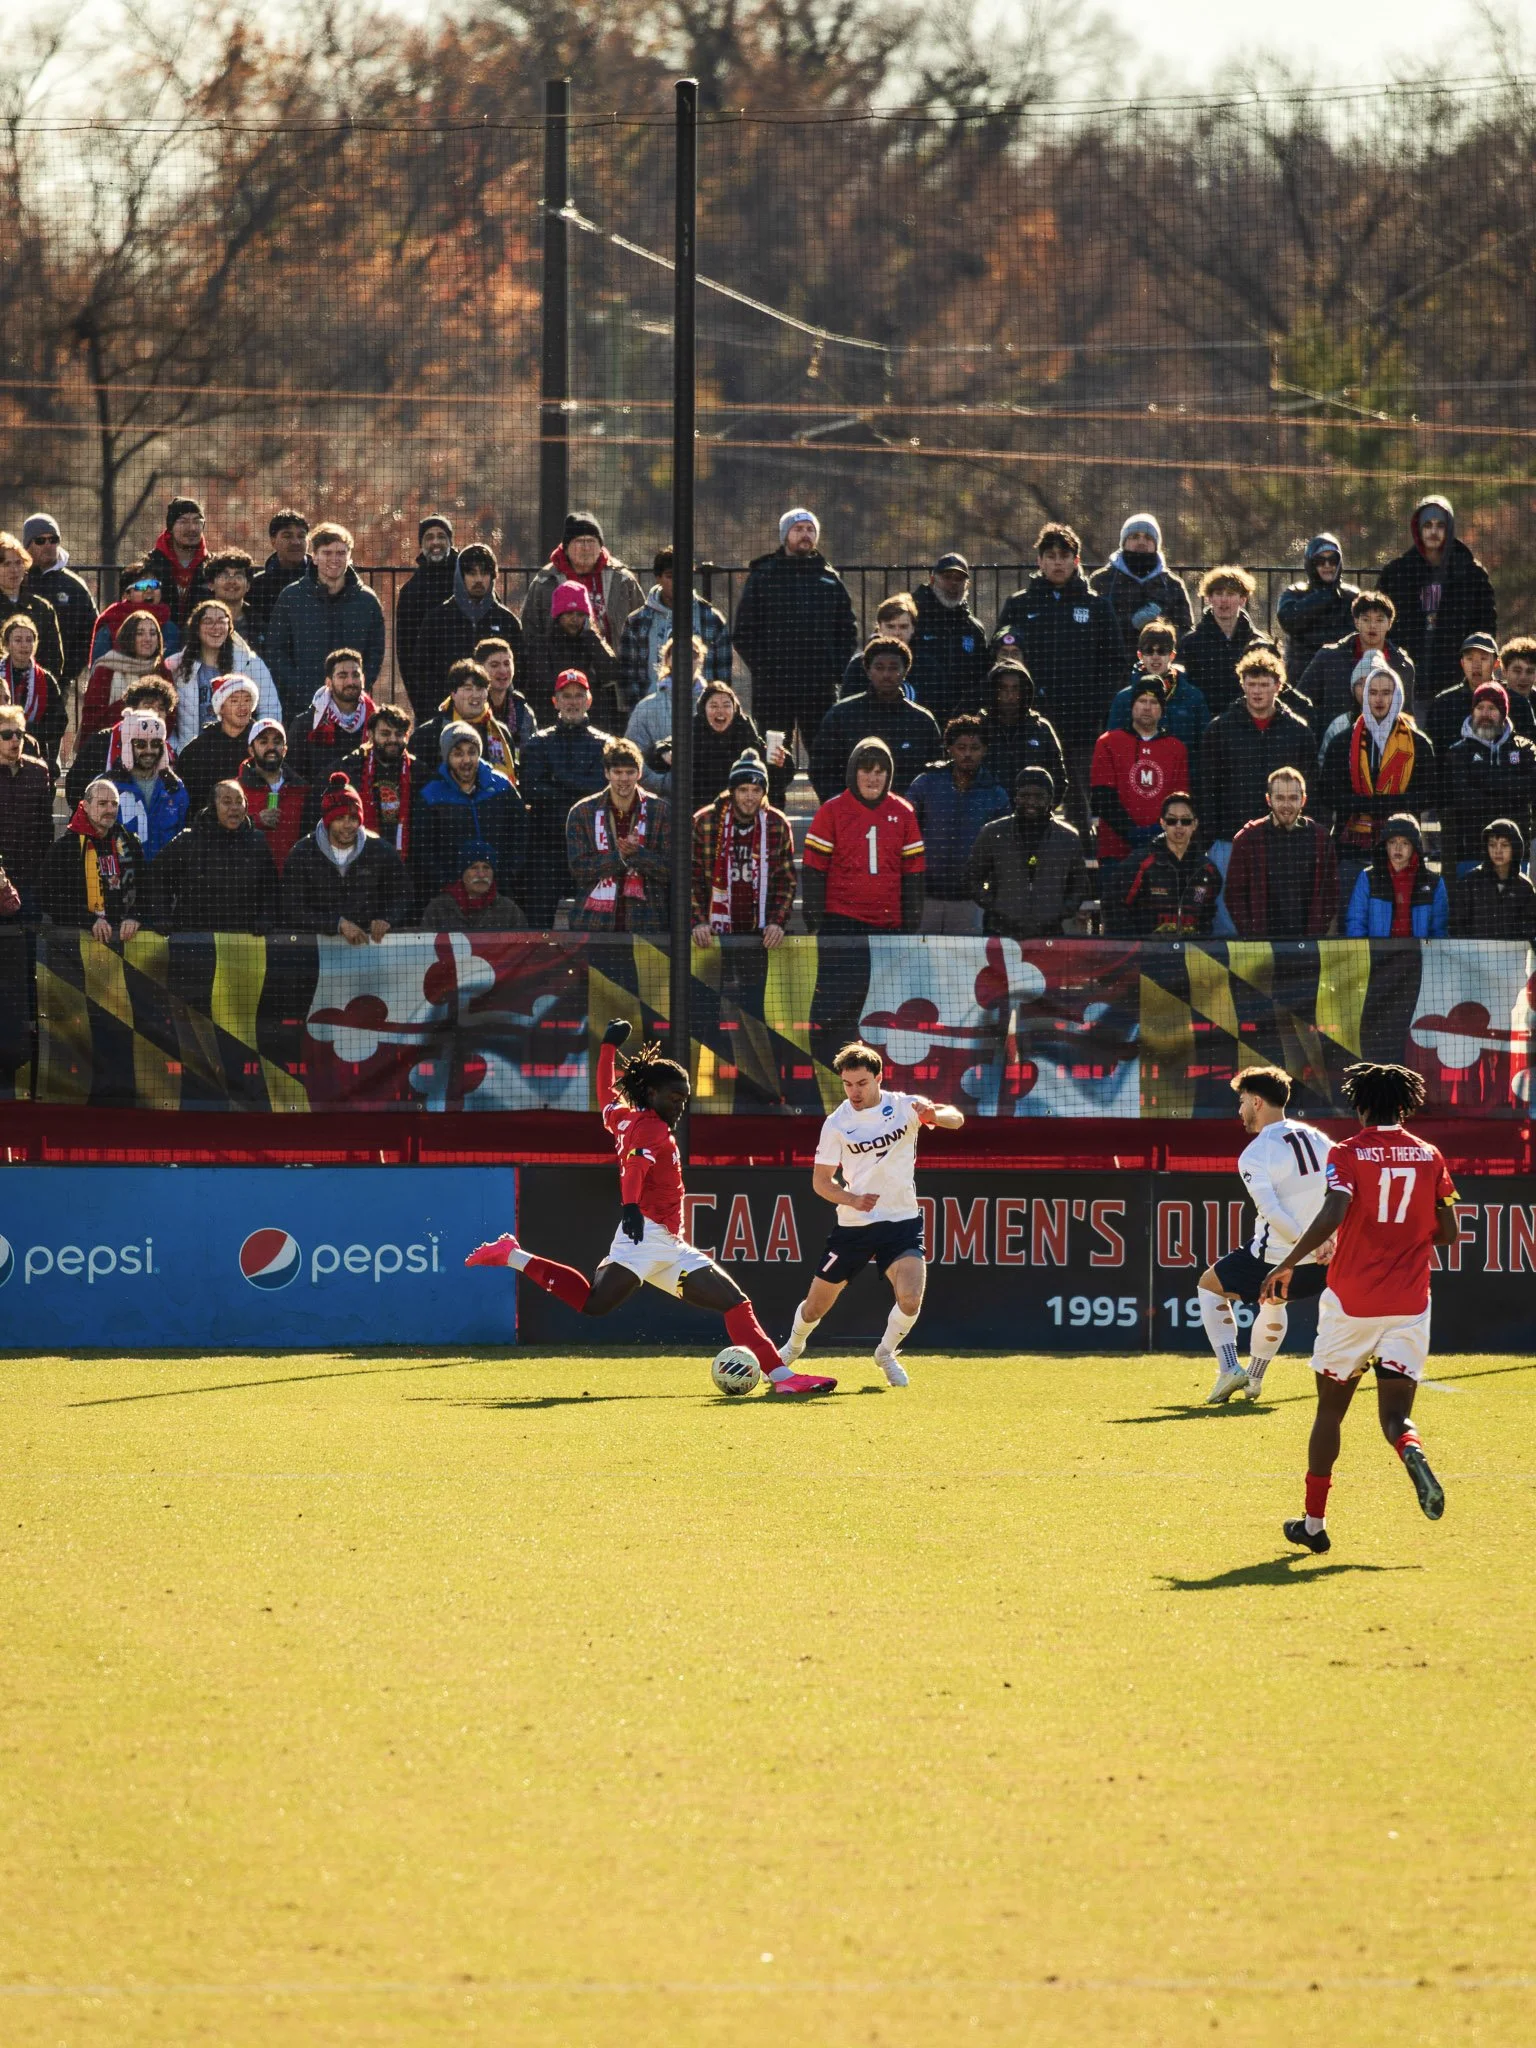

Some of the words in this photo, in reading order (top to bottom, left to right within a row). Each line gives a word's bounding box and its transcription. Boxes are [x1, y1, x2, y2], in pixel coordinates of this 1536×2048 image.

[1140, 769, 1153, 786] M
[865, 825, 878, 875] 1
[847, 1124, 908, 1154] UCONN
[1282, 1131, 1321, 1176] 11
[1377, 1167, 1417, 1223] 17
[682, 1194, 802, 1262] CAA
[24, 1237, 154, 1285] pepsi
[311, 1236, 440, 1284] pepsi
[825, 1251, 839, 1273] 7
[1046, 1295, 1138, 1328] 1995
[1163, 1297, 1255, 1329] 196
